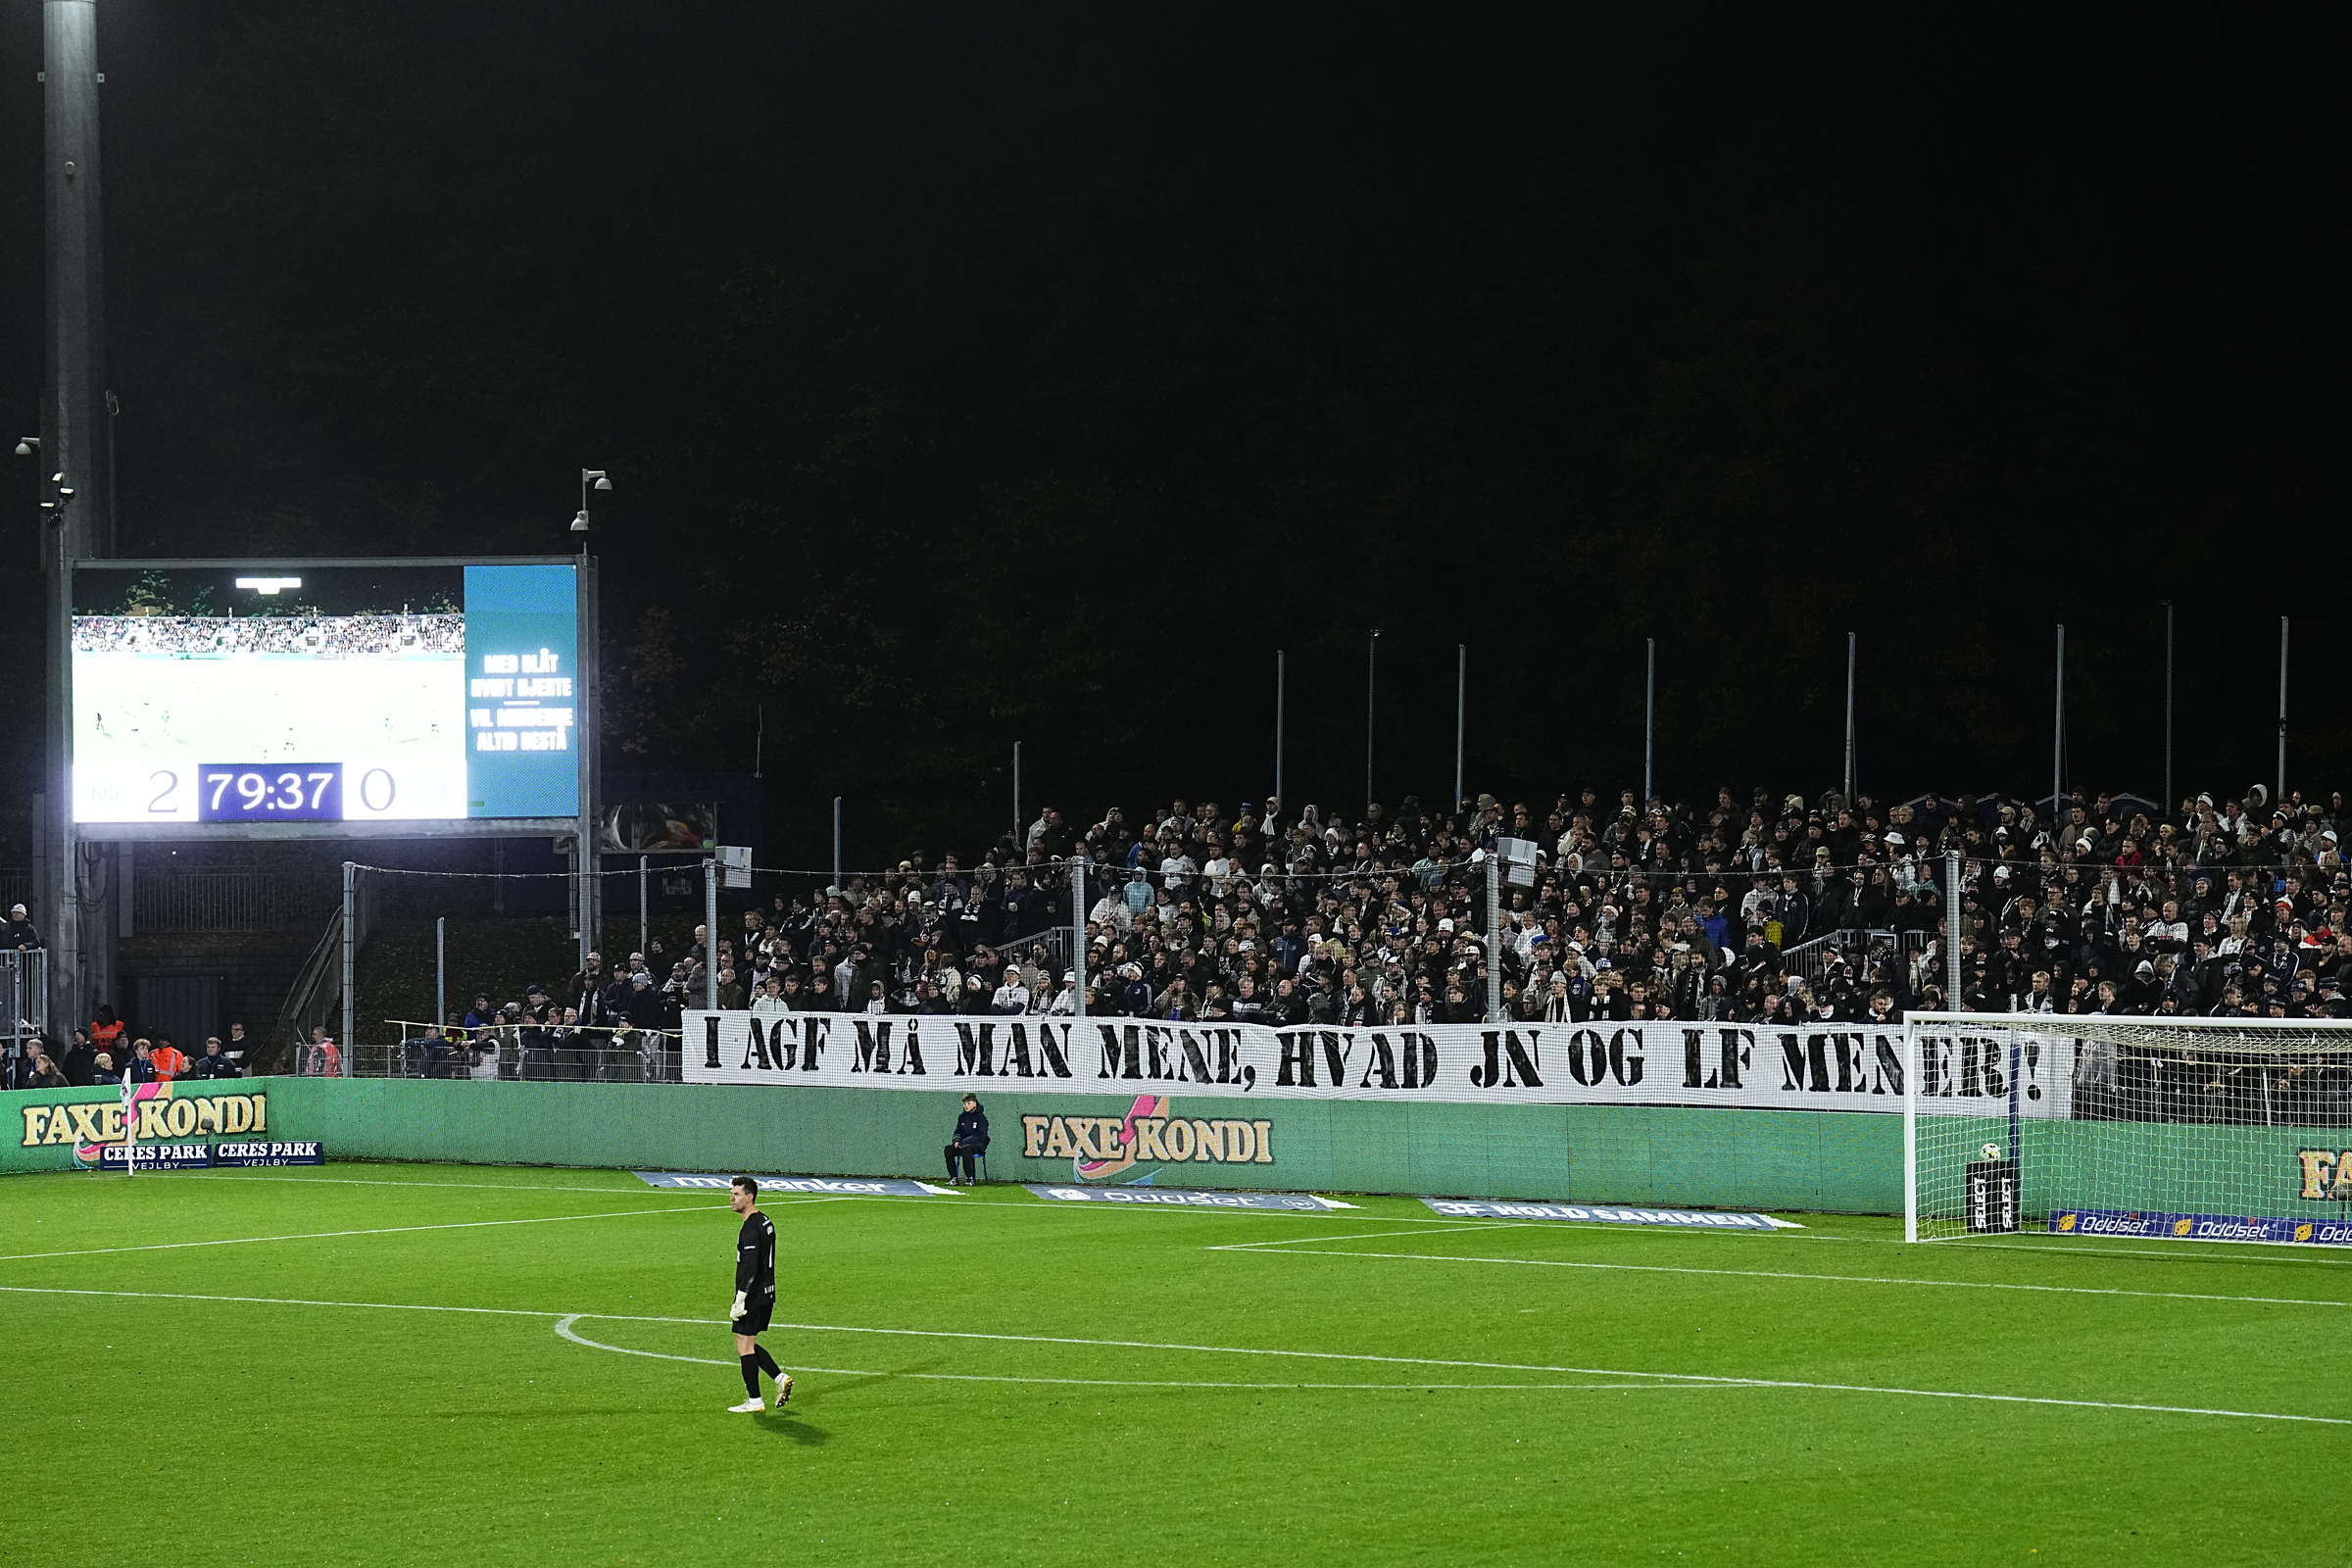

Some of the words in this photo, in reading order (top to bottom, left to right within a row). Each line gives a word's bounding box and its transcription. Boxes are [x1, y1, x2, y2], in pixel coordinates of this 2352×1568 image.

[147, 769, 179, 813] 2
[206, 772, 334, 811] 79:37
[360, 767, 397, 811] 0
[704, 1016, 721, 1068] I
[740, 1017, 831, 1071] AGF
[851, 1017, 927, 1075] MÅ
[955, 1022, 1073, 1078] MAN
[1097, 1024, 1256, 1093] MENE,
[1275, 1031, 1438, 1089] HVAD
[1470, 1030, 1544, 1088] JN
[1568, 1029, 1644, 1087] OG
[1682, 1029, 1755, 1089] LF
[1776, 1032, 2042, 1102] MENER!
[23, 1102, 128, 1146] FAXE
[138, 1095, 267, 1139] KONDI
[103, 1146, 157, 1161] CERES
[159, 1145, 208, 1160] PARK
[218, 1143, 268, 1157] CERES
[270, 1142, 318, 1157] PARK
[1023, 1115, 1124, 1161] FAXE
[1136, 1116, 1273, 1163] KONDI
[131, 1161, 180, 1170] VEJLBY
[243, 1158, 289, 1167] VEJLBY
[1103, 1192, 1261, 1206] Oddset
[1433, 1202, 1486, 1215] 3F
[1490, 1205, 1590, 1219] HOLD
[1592, 1209, 1762, 1226] SAMMEN
[1974, 1177, 1986, 1229] SELECT
[2001, 1177, 2012, 1229] SELECT
[2081, 1216, 2150, 1233] Oddset
[2197, 1221, 2270, 1238] Oddset
